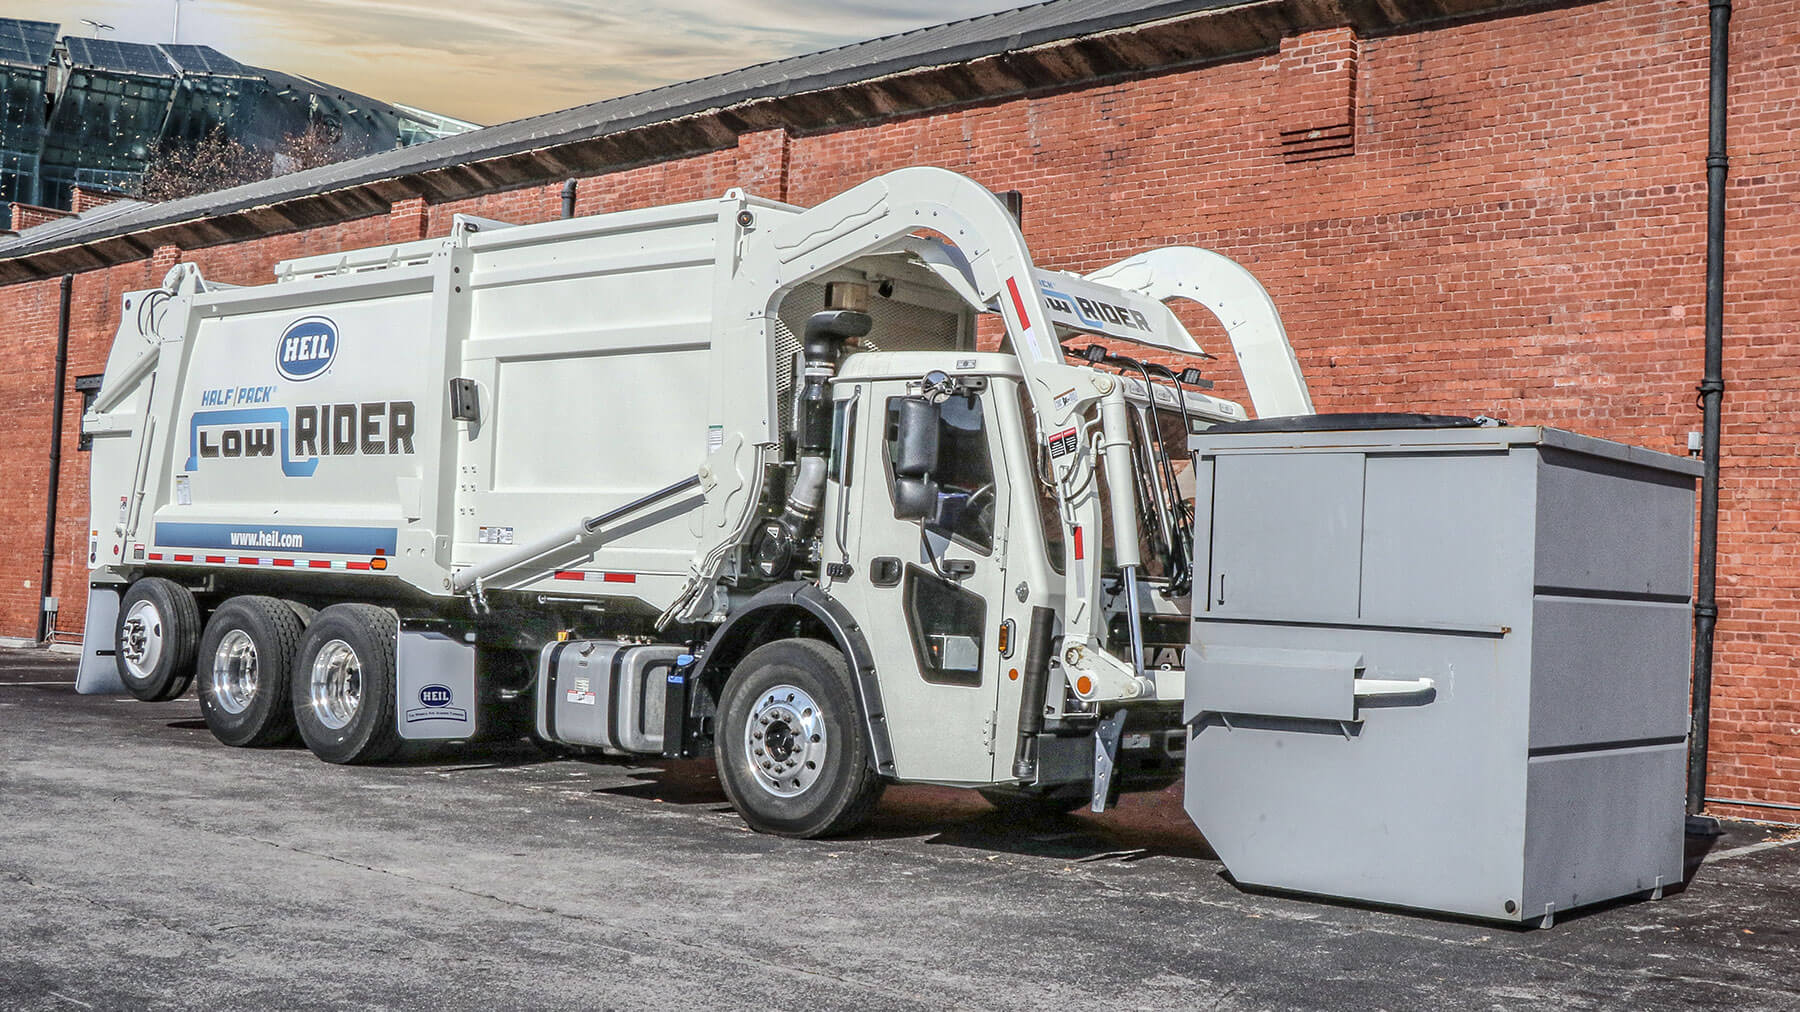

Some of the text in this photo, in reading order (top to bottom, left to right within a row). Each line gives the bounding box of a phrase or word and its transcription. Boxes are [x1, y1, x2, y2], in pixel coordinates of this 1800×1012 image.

[1043, 296, 1153, 332] W RIDER
[283, 334, 332, 362] HEIL
[199, 401, 416, 458] LOW RIDER
[230, 530, 303, 548] www.heil.com
[422, 691, 450, 702] HEIL
